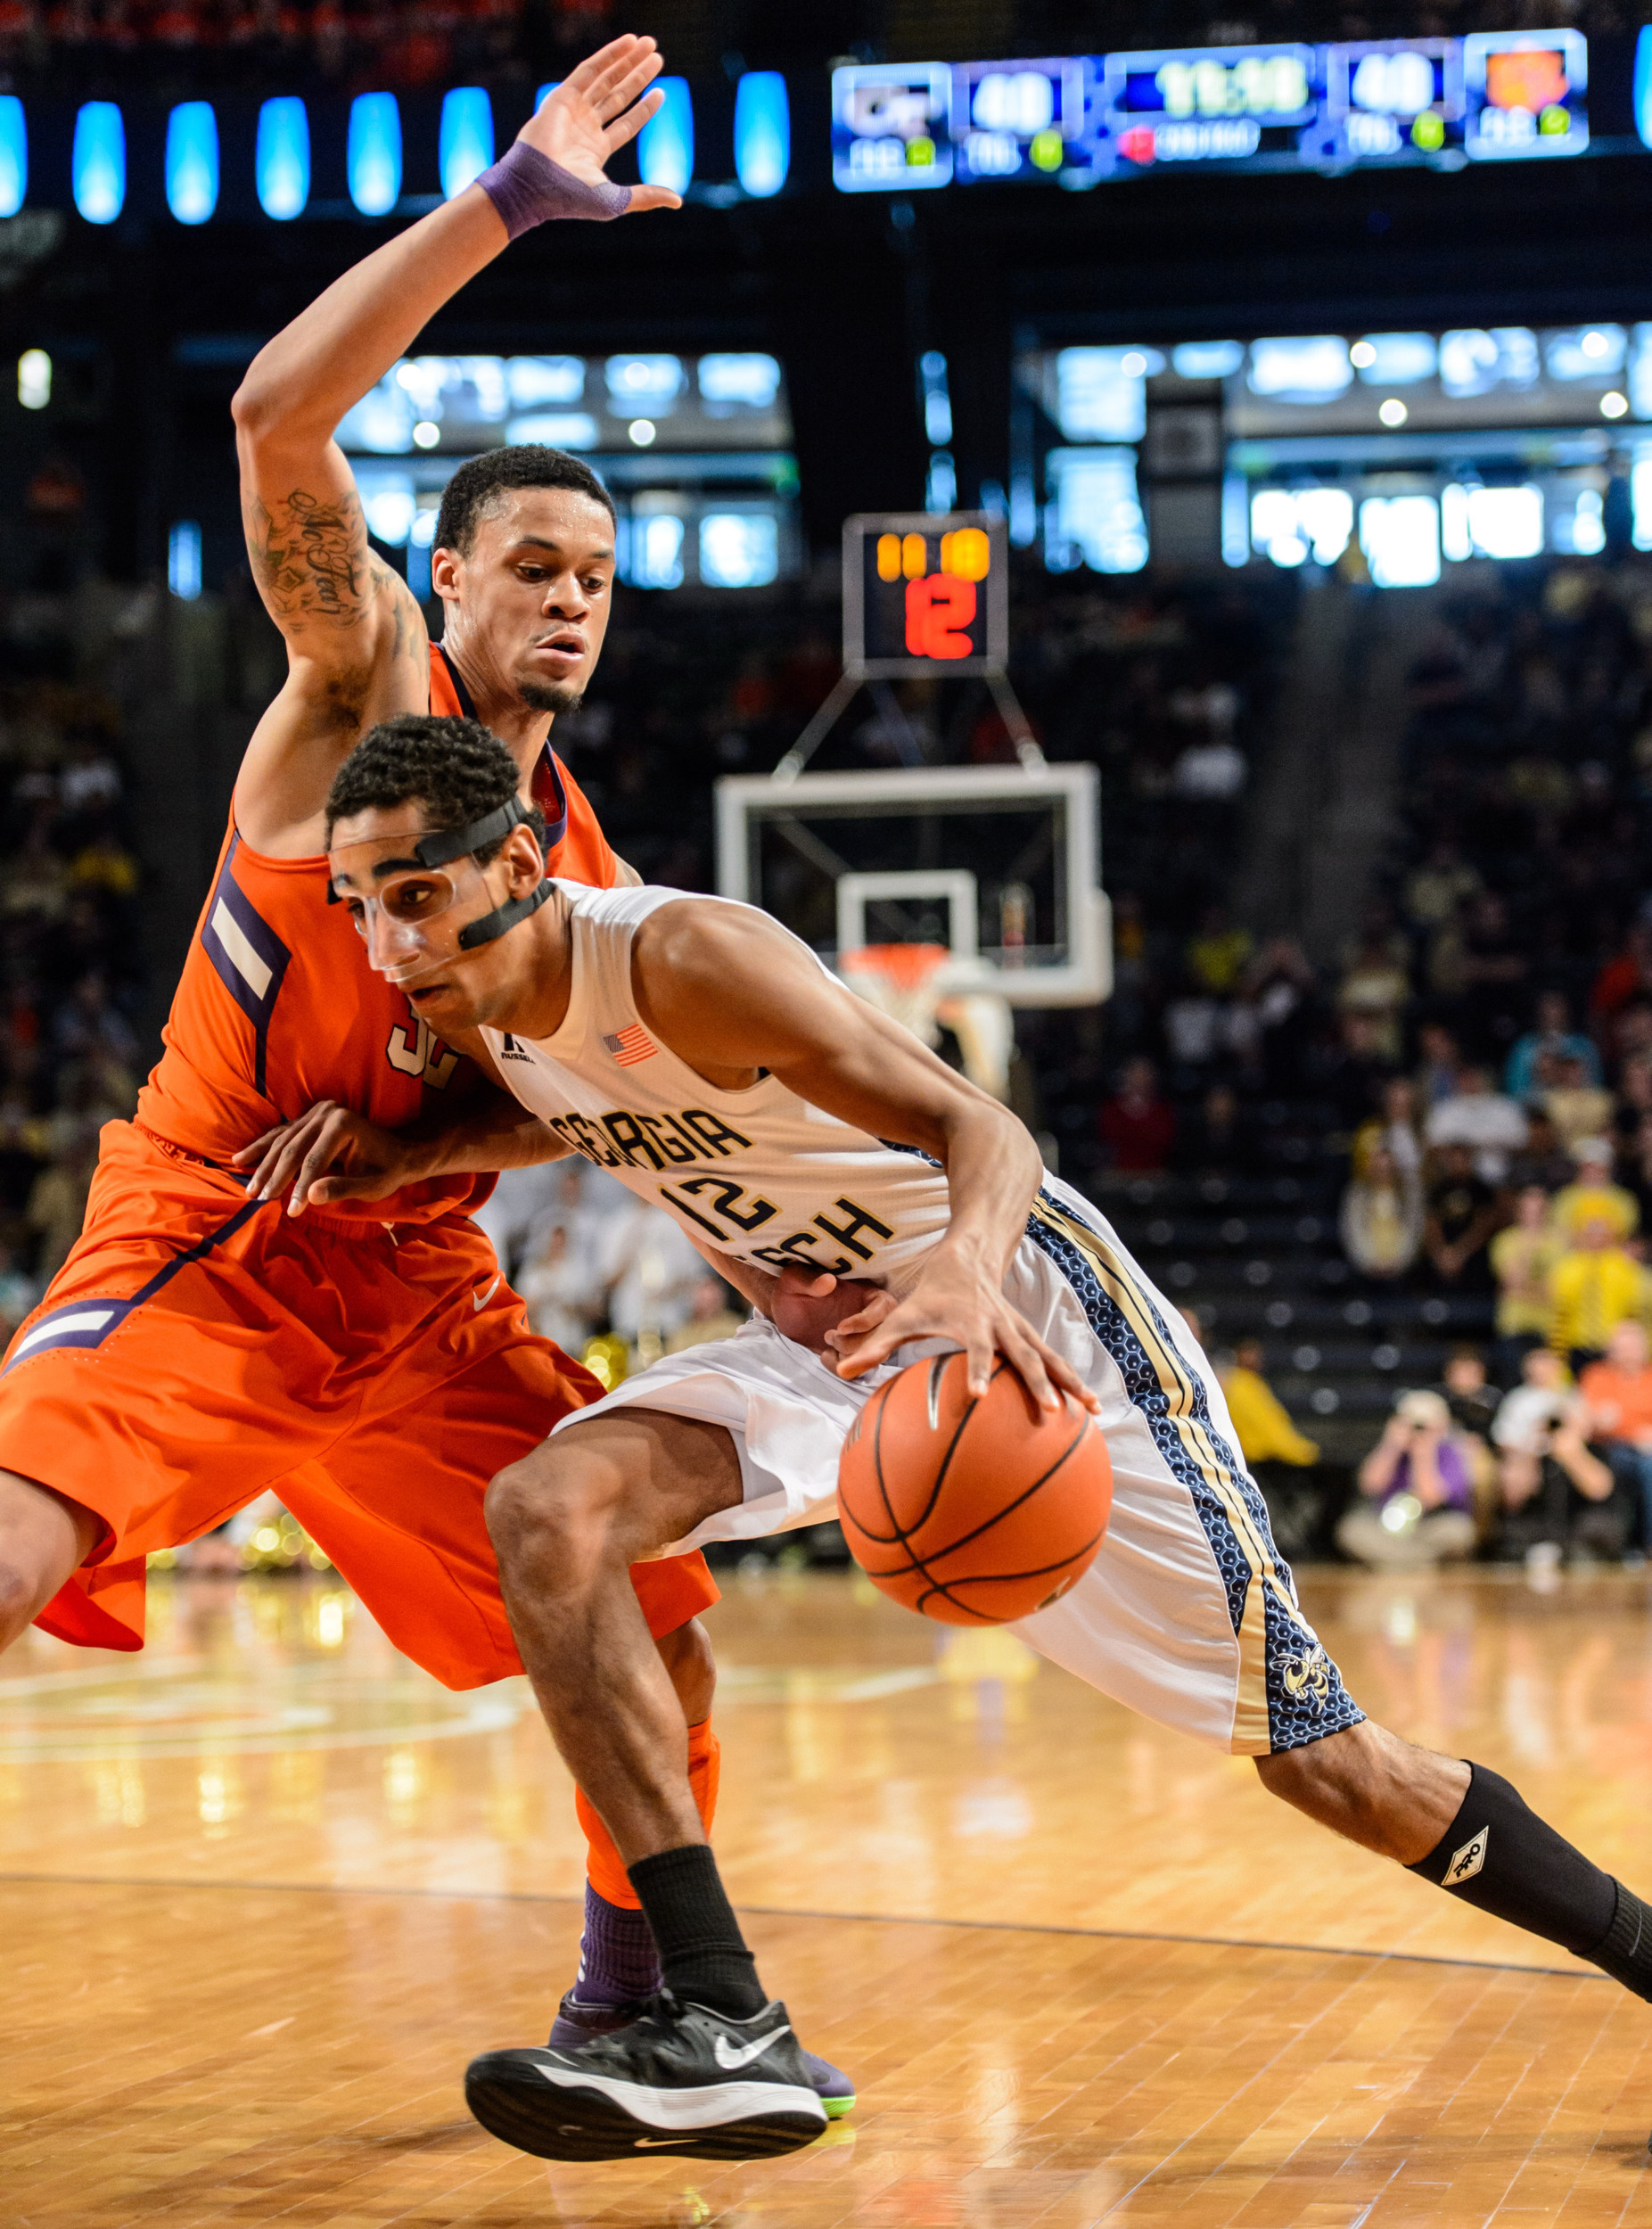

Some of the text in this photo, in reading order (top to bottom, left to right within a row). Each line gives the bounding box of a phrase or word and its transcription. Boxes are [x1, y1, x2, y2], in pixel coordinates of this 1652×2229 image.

[659, 1177, 783, 1242] 12
[733, 1195, 895, 1276] ECH
[1452, 1843, 1481, 1879] PRO
